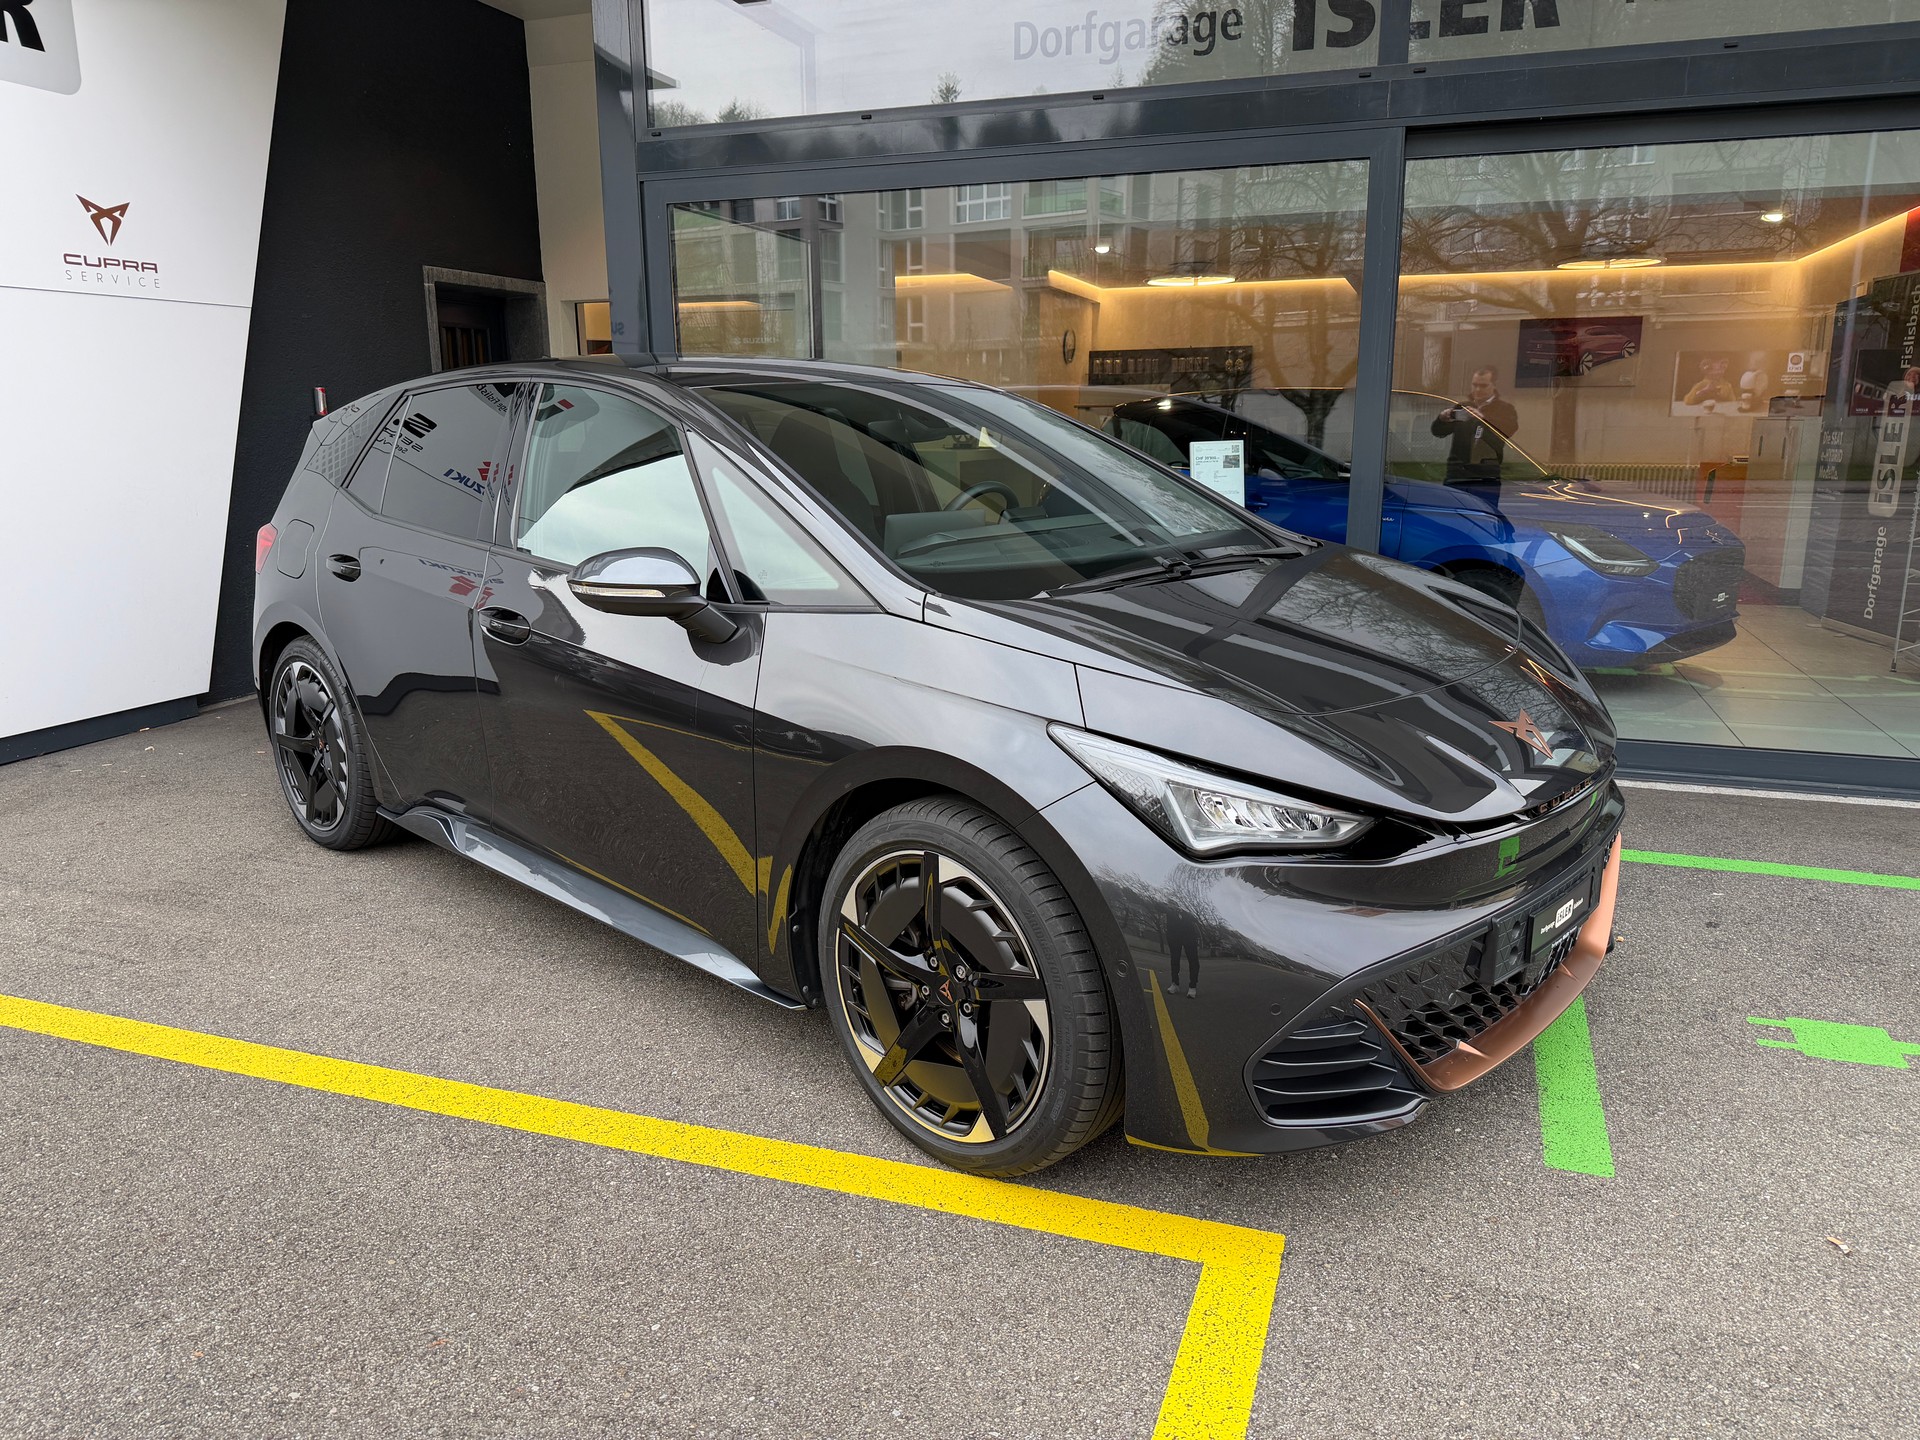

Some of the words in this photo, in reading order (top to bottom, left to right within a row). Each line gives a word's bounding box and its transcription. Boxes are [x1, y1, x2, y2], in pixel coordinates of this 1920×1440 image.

[63, 253, 159, 273] CUPRA
[65, 269, 161, 289] SERVICE
[1863, 526, 1887, 620] Dorfgarage
